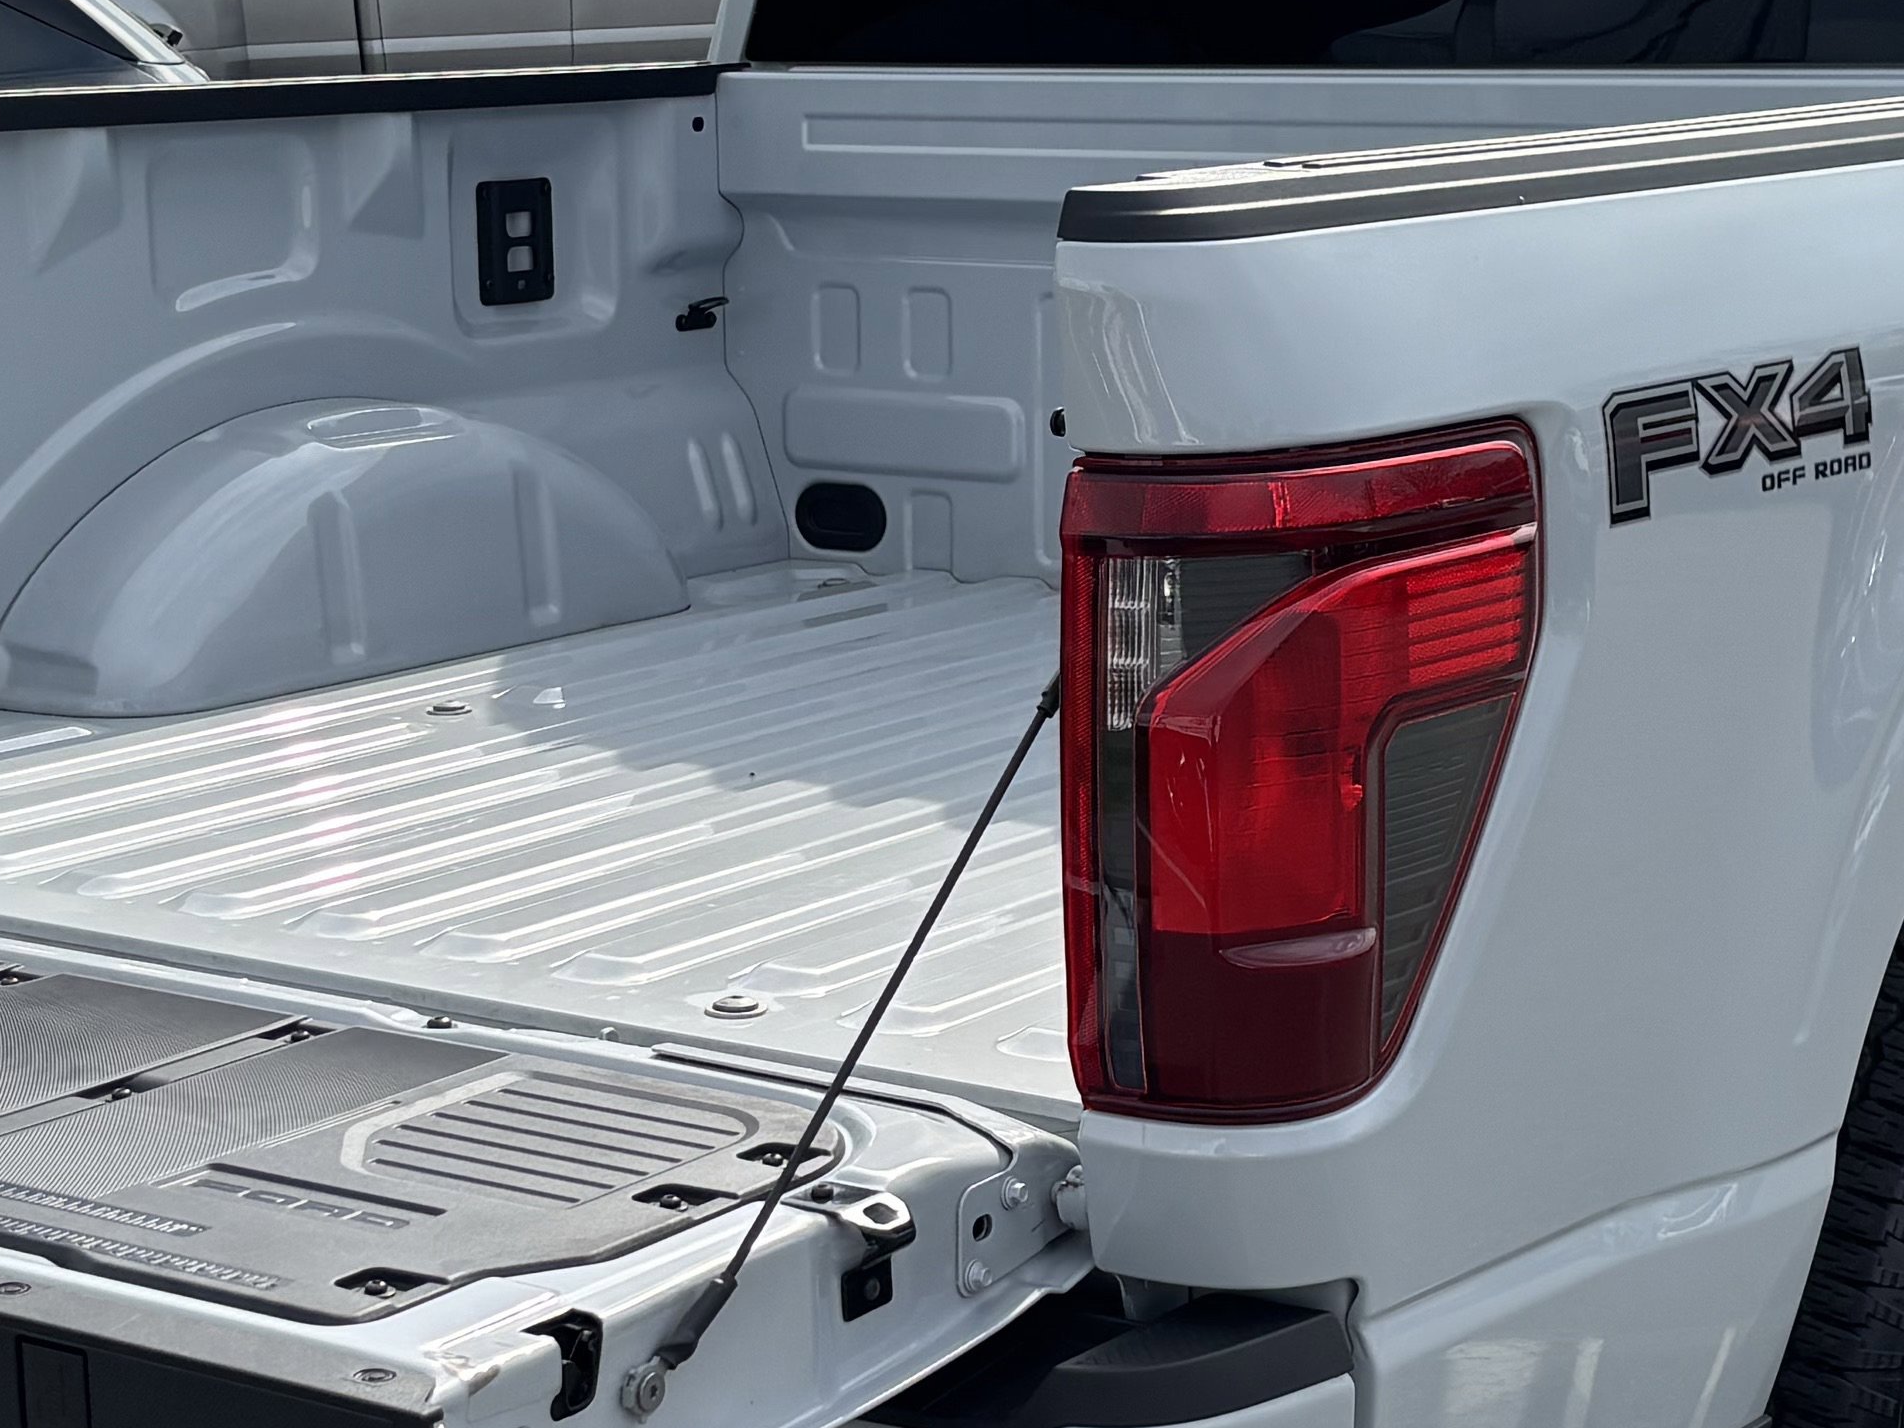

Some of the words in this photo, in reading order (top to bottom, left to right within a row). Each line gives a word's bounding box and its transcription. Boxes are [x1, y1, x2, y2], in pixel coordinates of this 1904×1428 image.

[1601, 342, 1874, 529] FX4
[1761, 467, 1807, 493] OFF
[1814, 451, 1873, 481] ROAD
